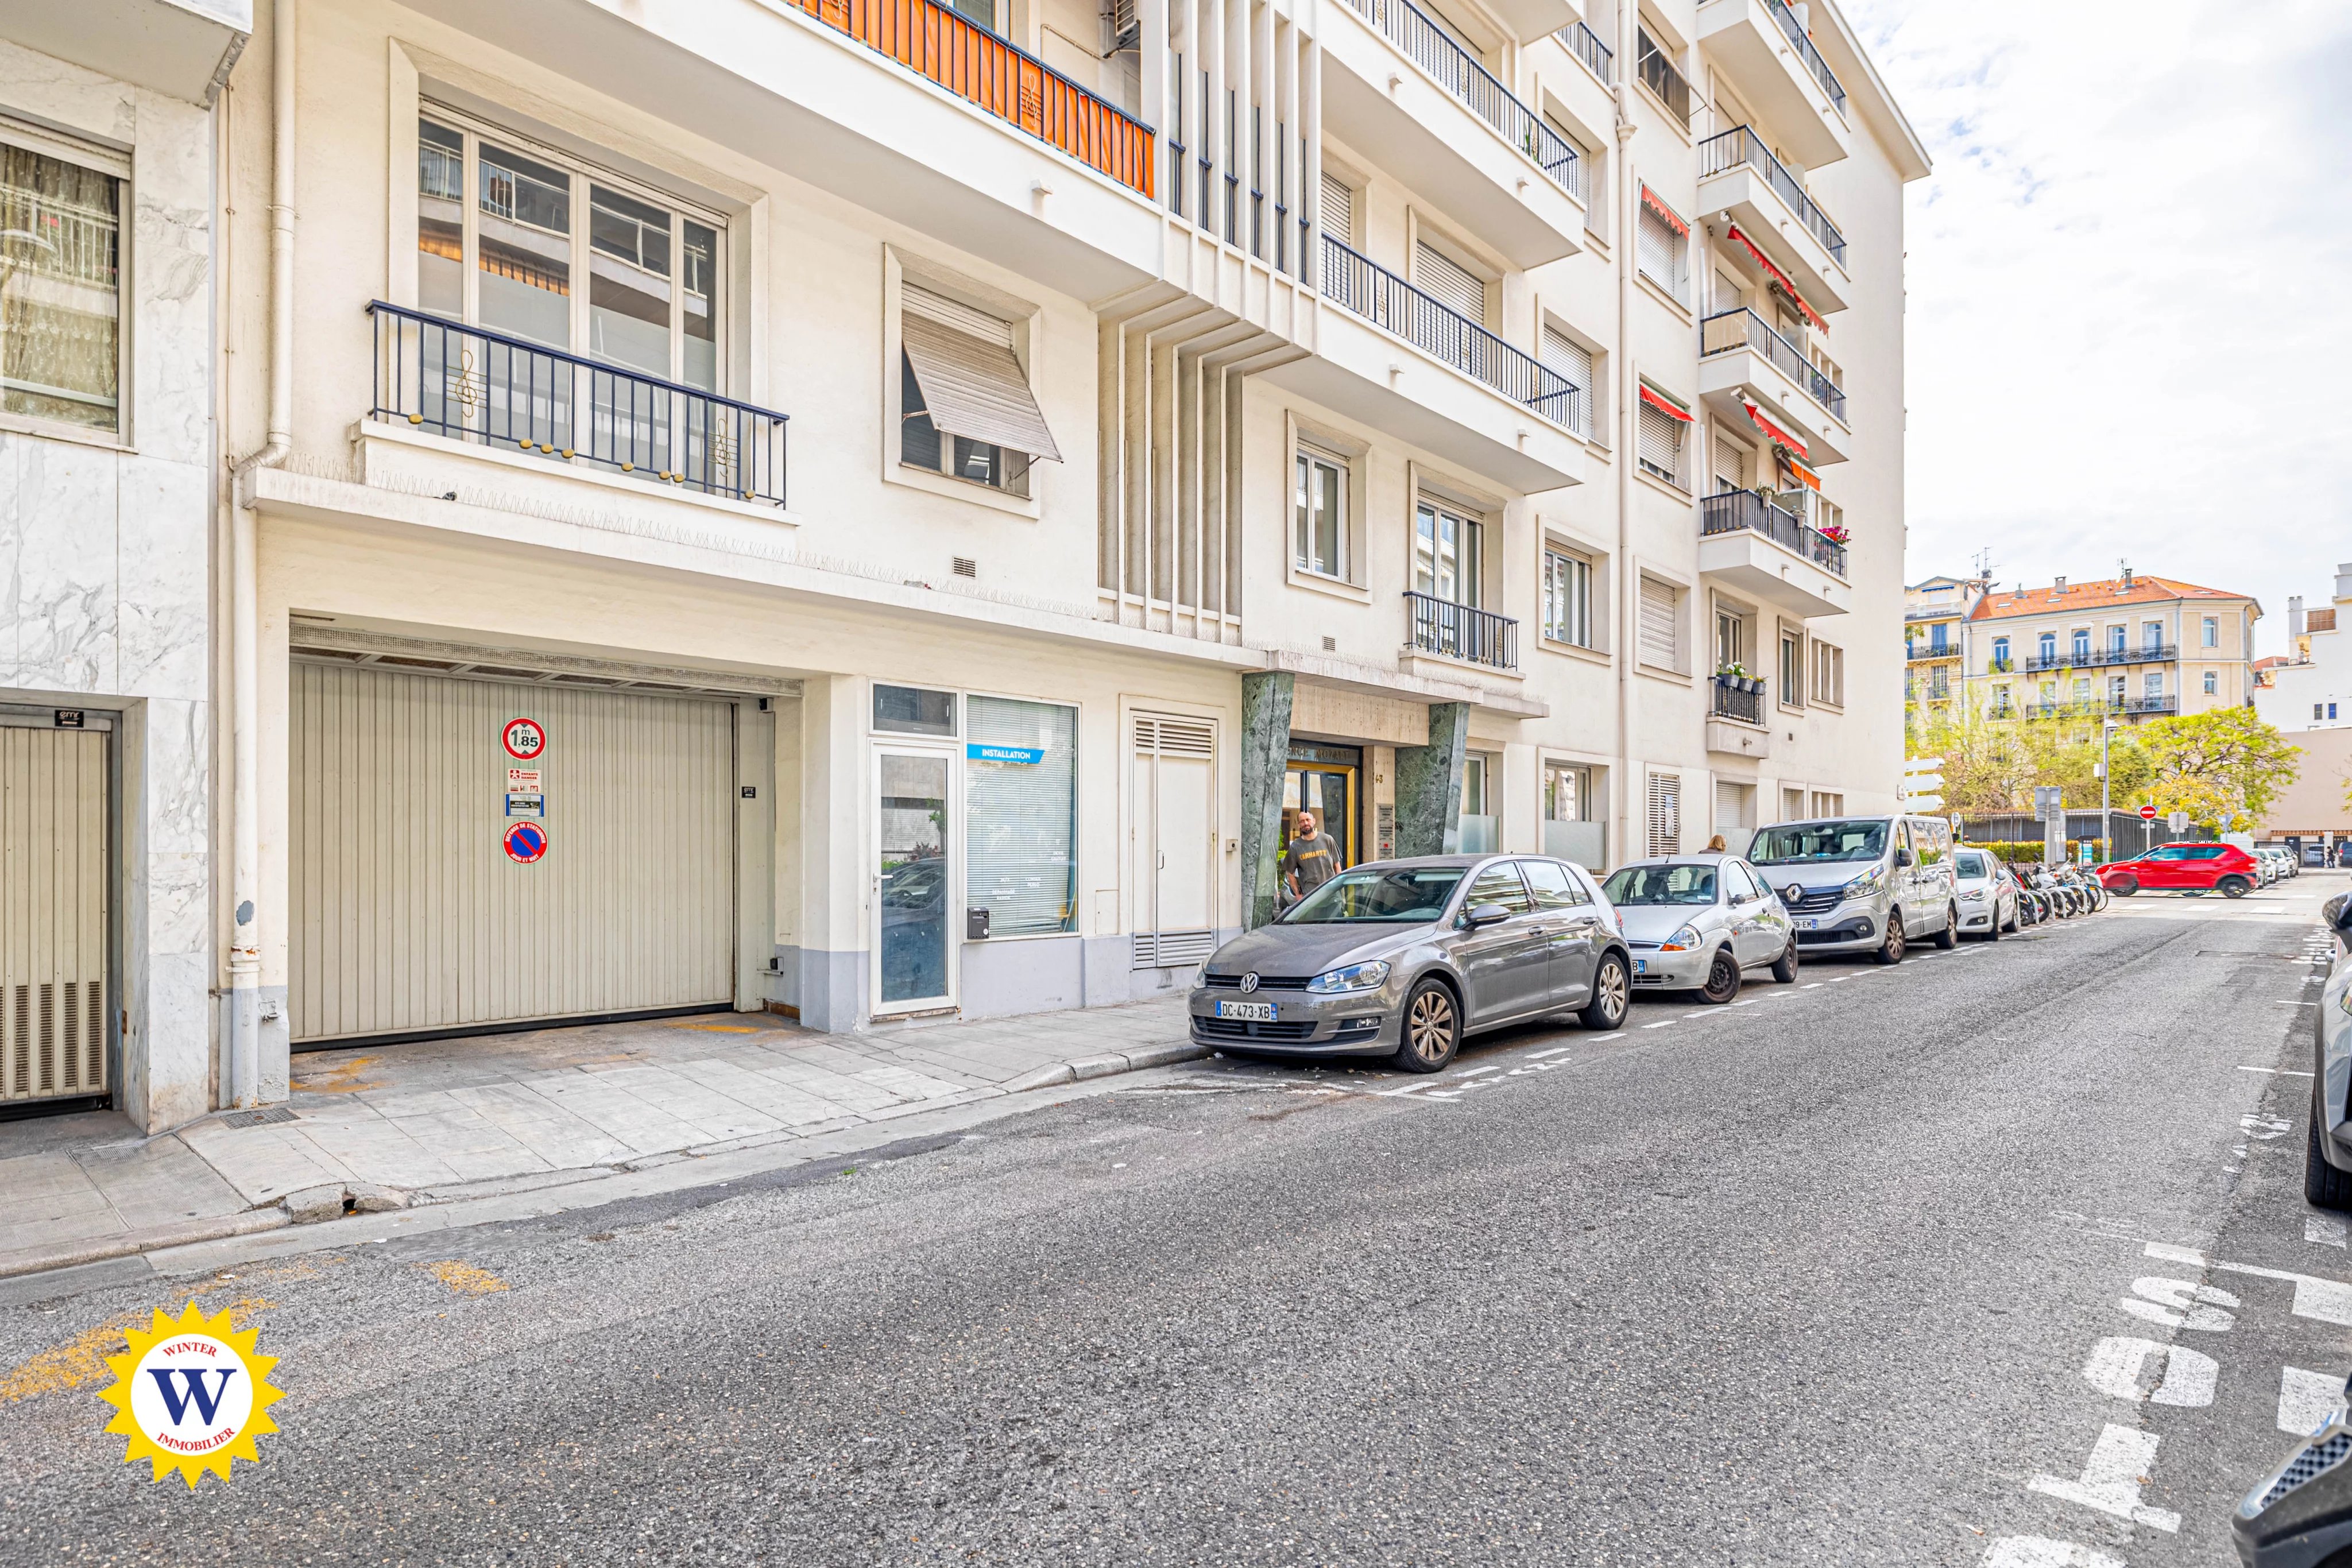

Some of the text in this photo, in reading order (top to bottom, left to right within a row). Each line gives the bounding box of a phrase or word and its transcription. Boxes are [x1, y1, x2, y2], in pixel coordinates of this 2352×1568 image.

[511, 729, 538, 748] 1,85
[982, 748, 1031, 759] INSTALLATION
[1314, 748, 1351, 761] MOZART
[1375, 774, 1383, 783] 43
[527, 823, 546, 844] STATIONNER
[510, 853, 522, 862] JOUR
[528, 853, 539, 862] NUIT
[1299, 849, 1327, 861] CARHARTT
[1223, 1004, 1270, 1019] DC-473-XB
